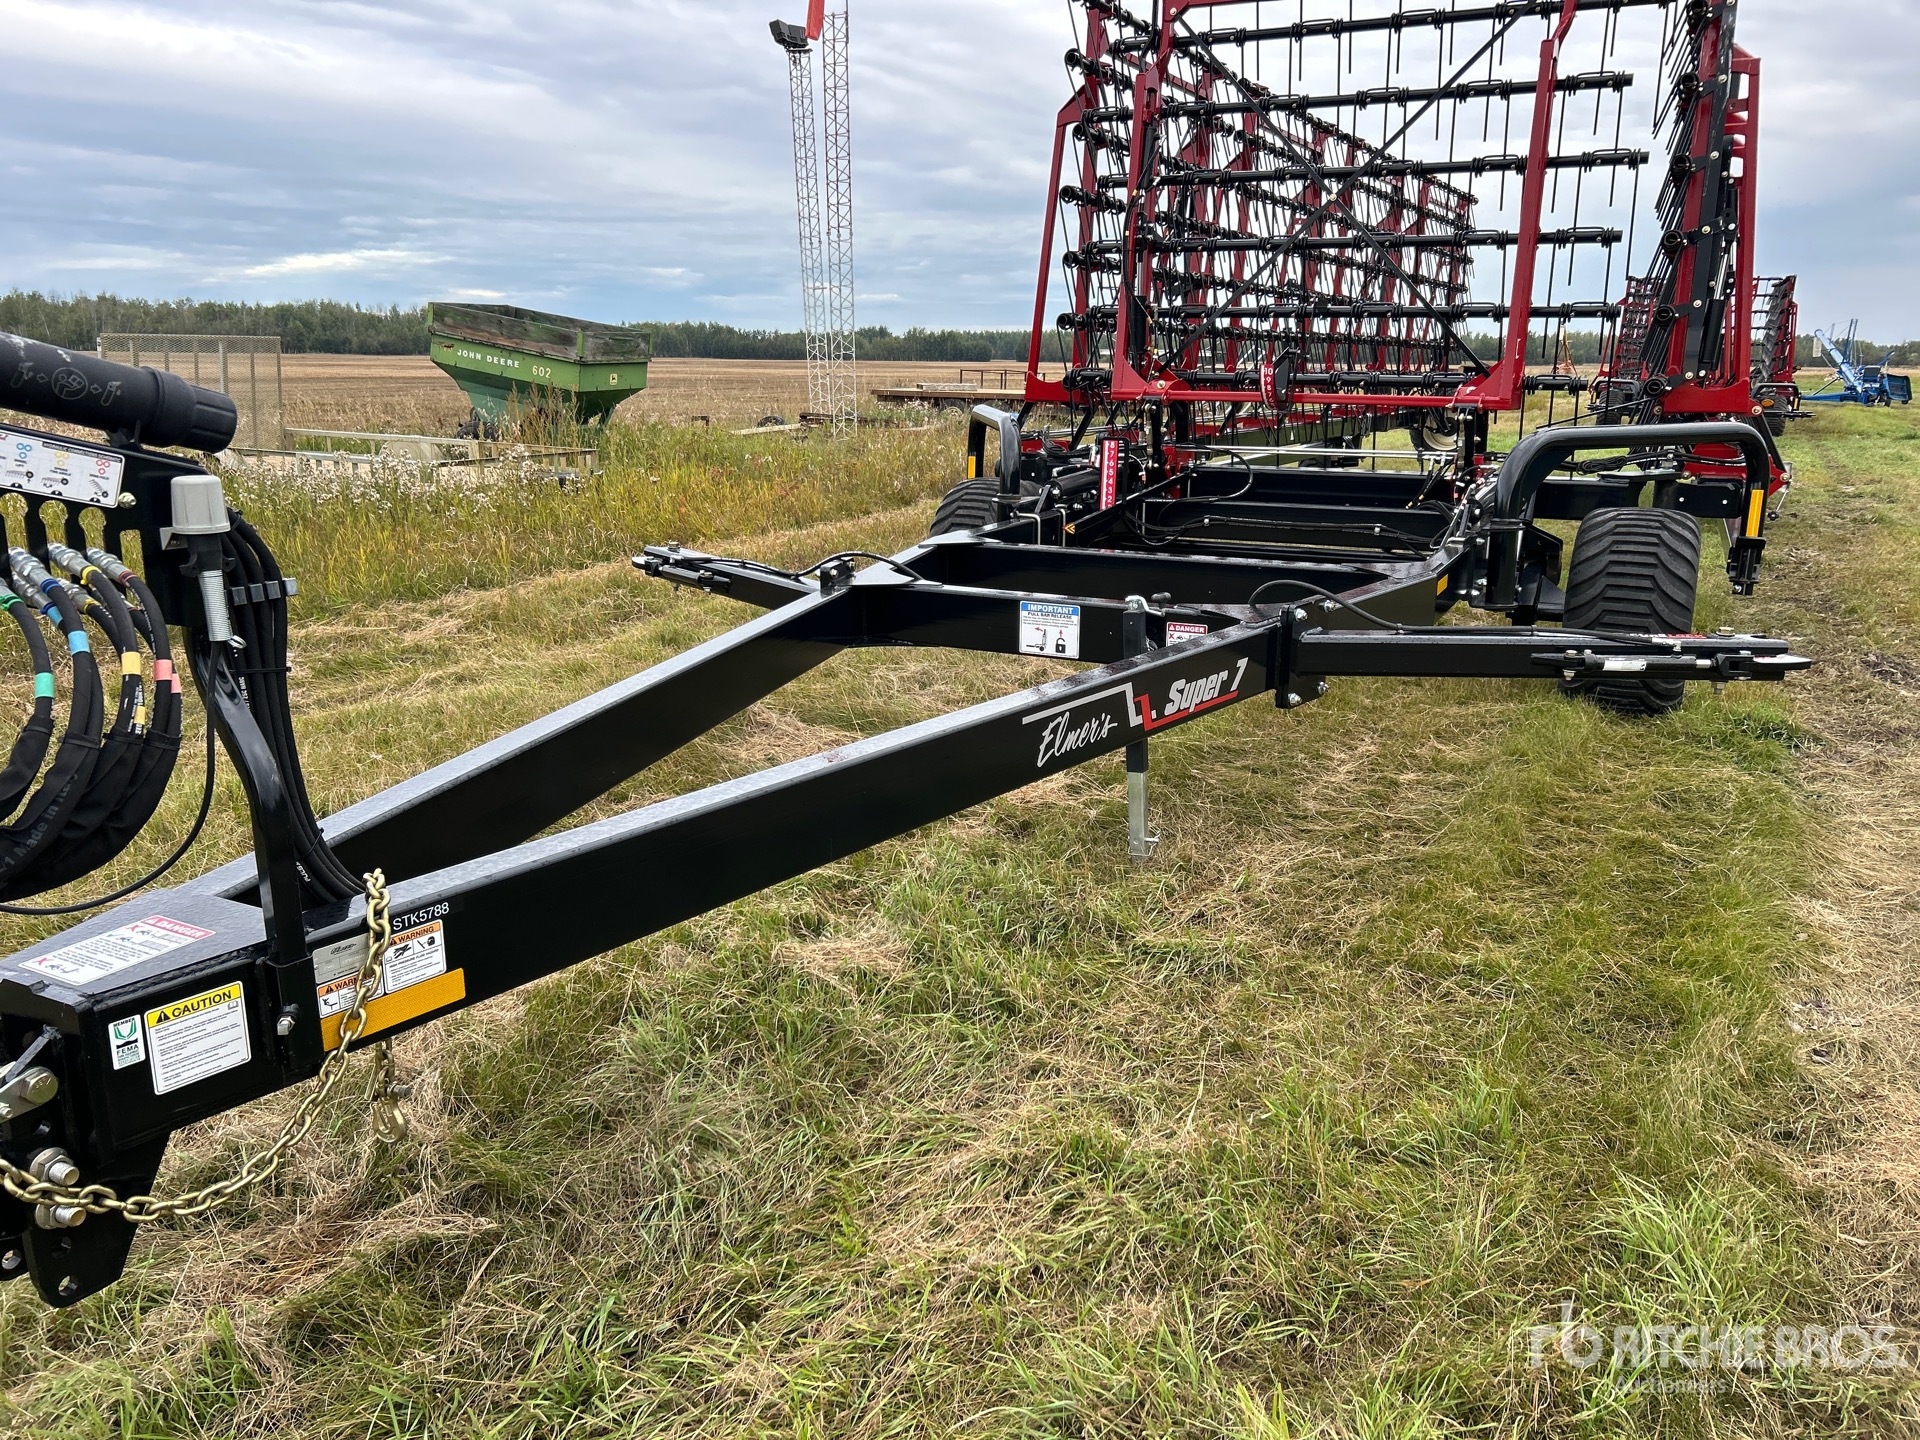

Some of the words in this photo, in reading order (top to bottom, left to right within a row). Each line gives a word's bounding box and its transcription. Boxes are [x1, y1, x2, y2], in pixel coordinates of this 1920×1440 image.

[457, 349, 481, 360] JOHN
[486, 355, 520, 368] DEERE
[532, 365, 551, 378] 602
[1028, 604, 1074, 614] IMPORTANT
[1176, 625, 1205, 633] DANGER
[1164, 669, 1228, 717] Super
[1230, 657, 1249, 692] 7
[1036, 711, 1118, 768] Elmer's
[392, 902, 450, 930] STK5788
[158, 921, 206, 938] DANGER
[398, 926, 434, 943] WARNING
[172, 990, 232, 1017] CAUTION
[113, 1017, 135, 1027] MEMBER
[117, 1044, 138, 1055] FEMA
